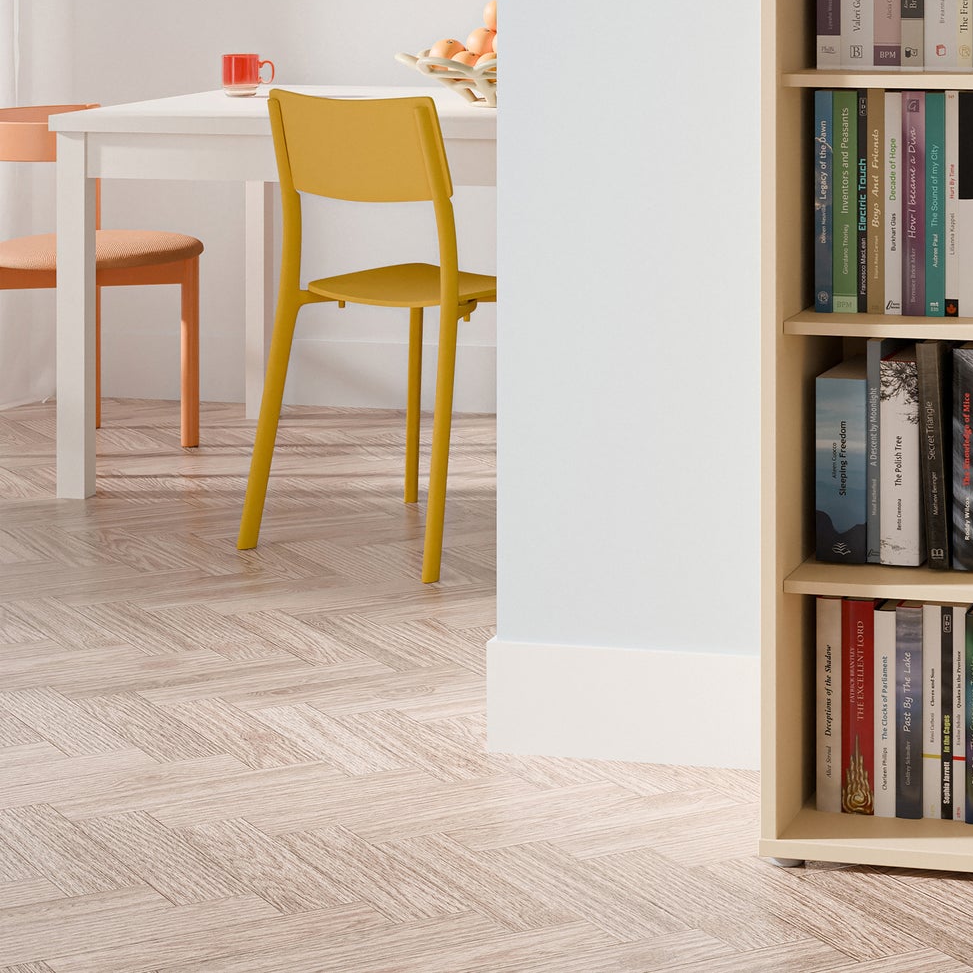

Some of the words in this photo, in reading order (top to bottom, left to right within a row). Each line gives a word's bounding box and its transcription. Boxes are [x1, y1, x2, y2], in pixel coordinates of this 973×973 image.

[852, 10, 860, 31] Valeri
[960, 17, 968, 33] The
[818, 121, 826, 143] Dawn
[907, 127, 916, 154] Diva
[820, 144, 829, 158] the
[910, 156, 916, 164] a
[931, 145, 939, 160] City
[820, 161, 826, 169] of
[858, 158, 867, 191] Touch
[889, 161, 896, 169] of
[933, 162, 939, 174] my
[820, 172, 828, 199] Legacy
[908, 167, 916, 205] became
[931, 176, 937, 184] of
[858, 194, 867, 231] Electric
[872, 203, 881, 227] Boys
[907, 214, 916, 238] How
[925, 401, 935, 433] Triangle
[963, 414, 970, 422] of
[837, 421, 848, 458] Freedom
[962, 423, 973, 470] Knowledge
[837, 459, 848, 495] Sleeping
[963, 471, 973, 485] The
[903, 652, 911, 673] Lake
[903, 677, 911, 693] The
[903, 697, 913, 708] By
[903, 712, 911, 732] Past
